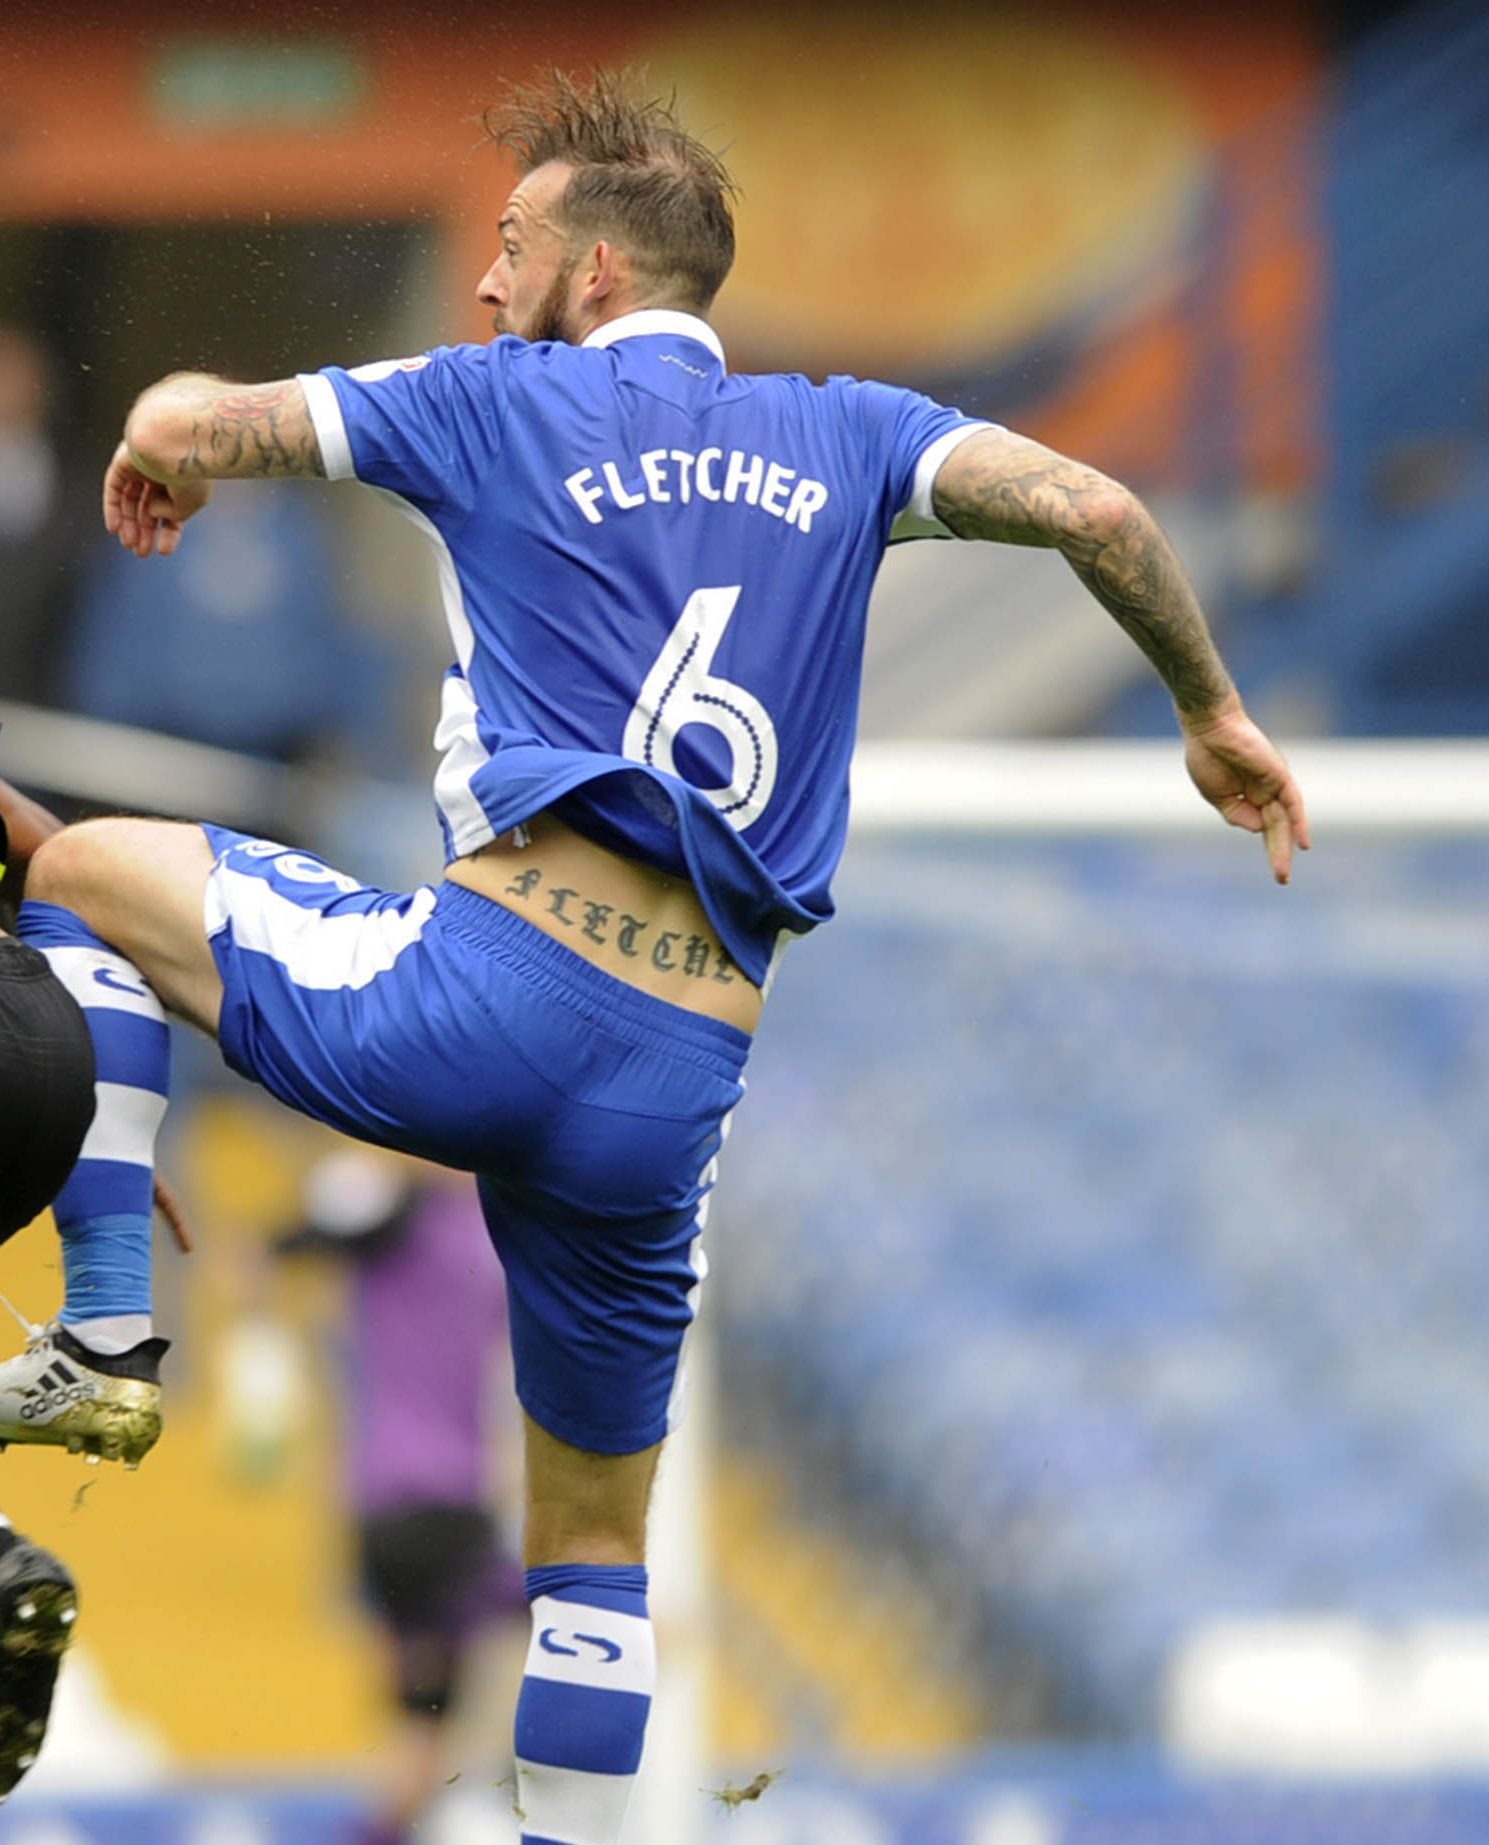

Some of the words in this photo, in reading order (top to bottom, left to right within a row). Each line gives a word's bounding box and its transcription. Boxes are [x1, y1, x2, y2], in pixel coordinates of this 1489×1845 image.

[564, 446, 829, 534] FLETCHER
[622, 585, 778, 833] 6
[20, 1382, 95, 1420] adidas
